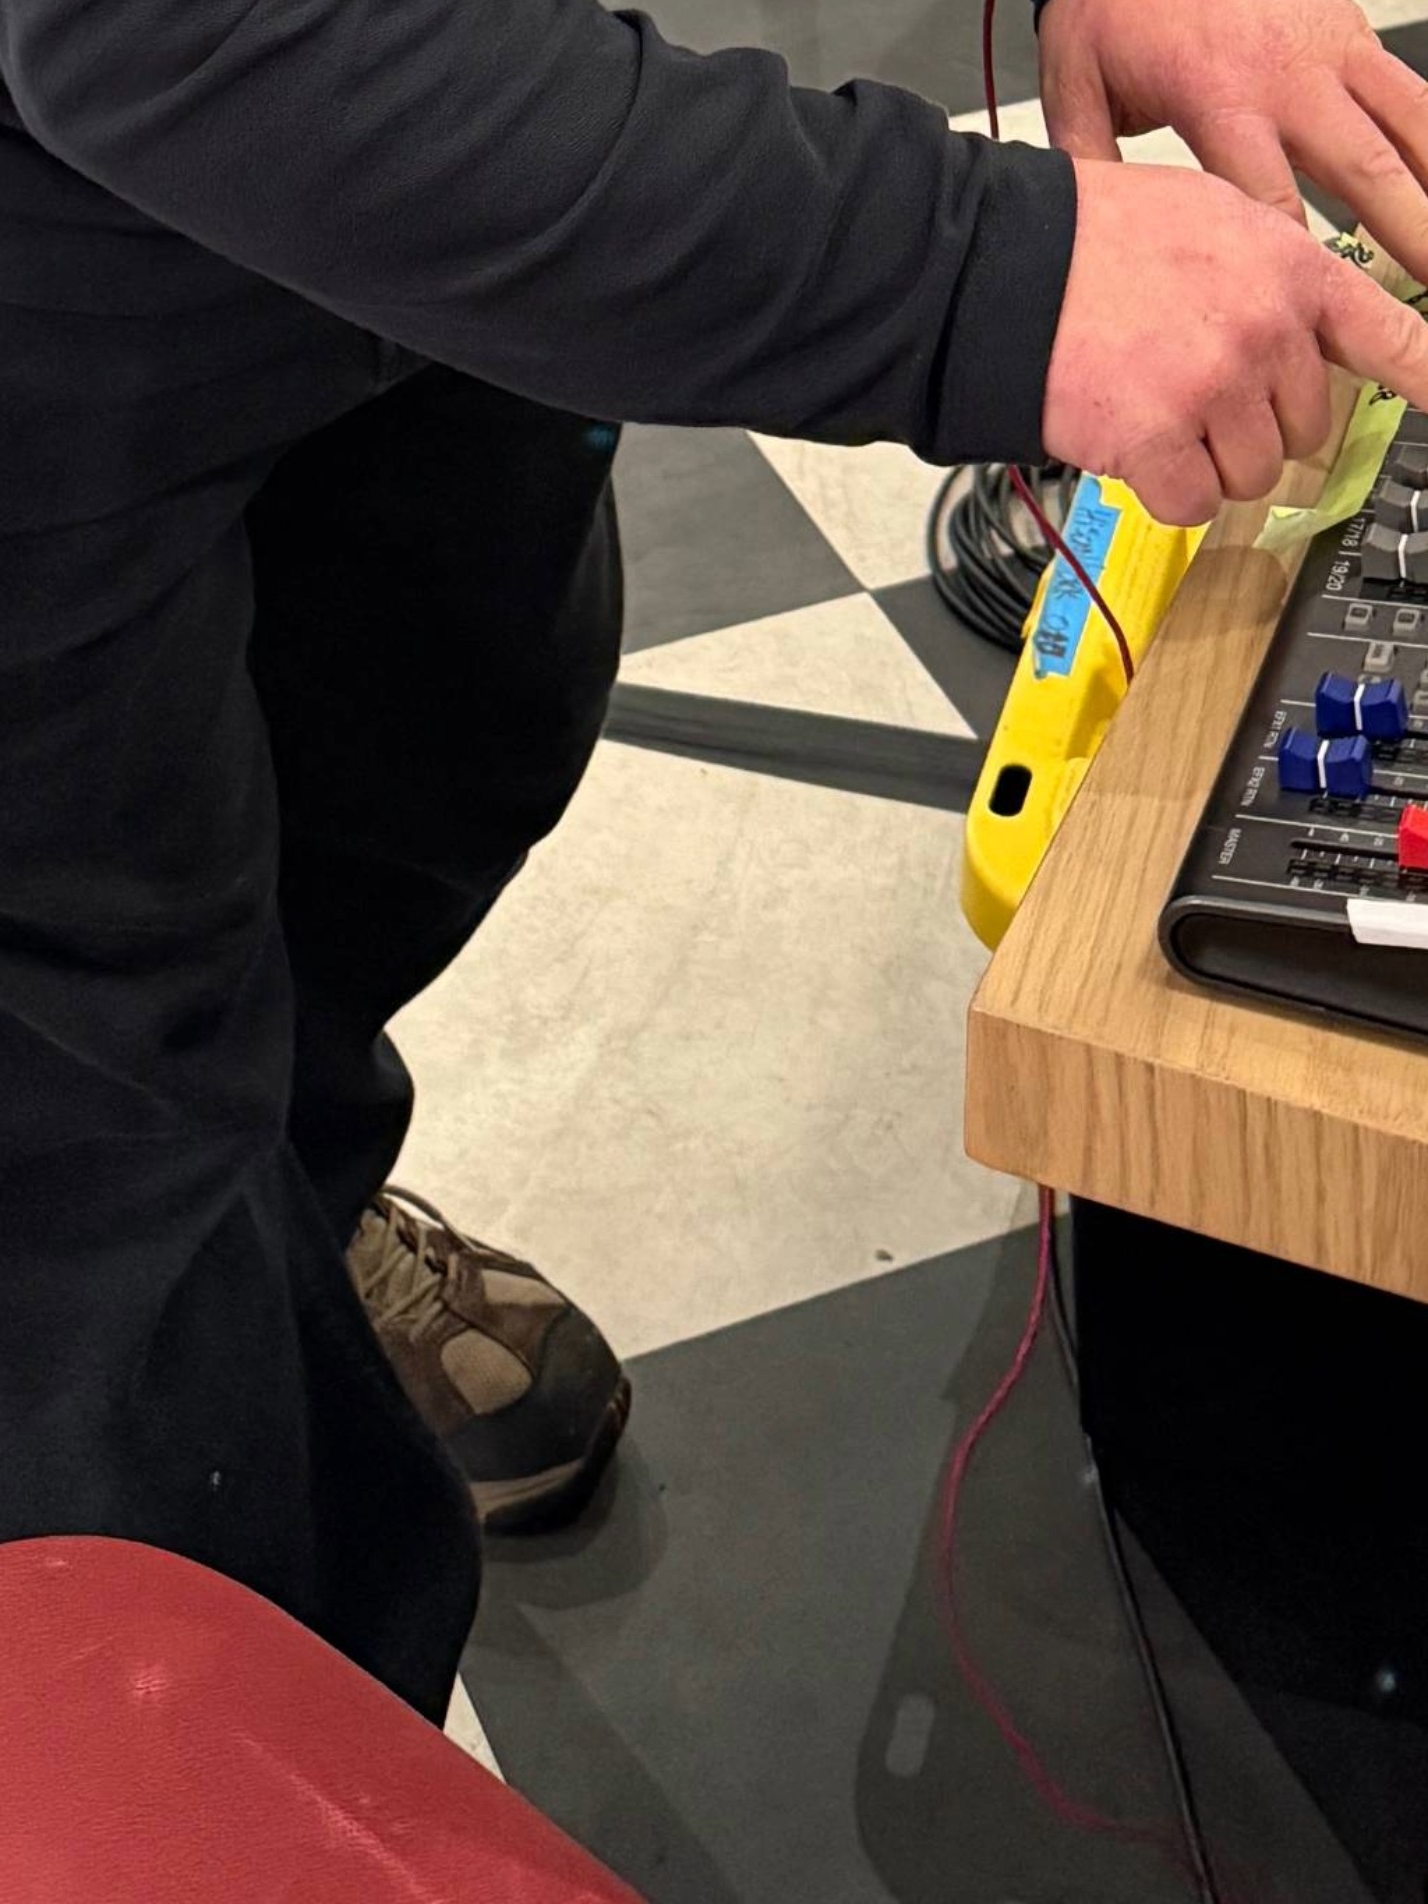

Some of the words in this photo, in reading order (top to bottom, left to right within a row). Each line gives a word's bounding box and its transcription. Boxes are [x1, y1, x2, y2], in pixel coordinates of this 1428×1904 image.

[1342, 517, 1366, 547] 17/18
[1326, 560, 1349, 590] 19/20
[1218, 829, 1241, 865] MASTER
